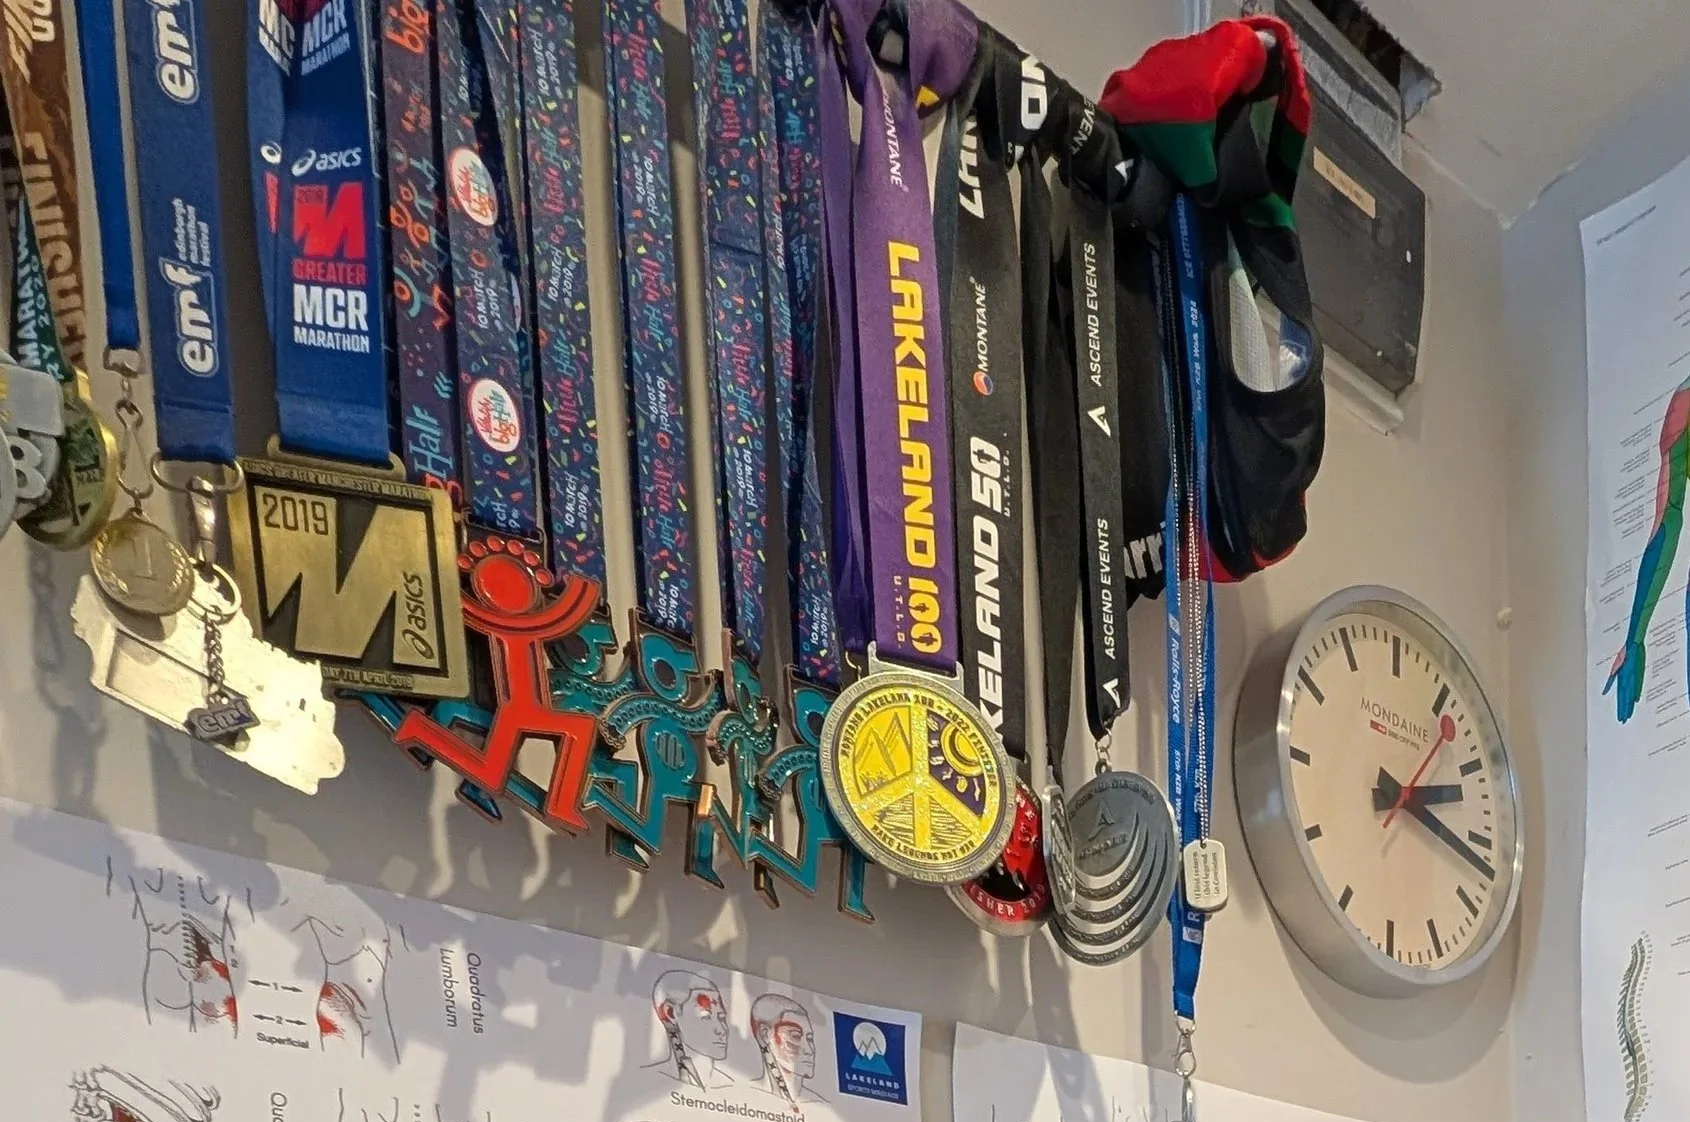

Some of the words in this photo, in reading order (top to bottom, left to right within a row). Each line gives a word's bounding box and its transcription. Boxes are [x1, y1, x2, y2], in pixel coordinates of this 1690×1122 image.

[292, 258, 367, 285] GREATER
[1083, 242, 1098, 313] EVENTS
[162, 261, 216, 375] emf
[293, 283, 369, 332] MCR
[294, 325, 370, 353] MARATHON
[977, 281, 991, 372] MONTANE
[1087, 318, 1102, 388] ASCEND
[887, 240, 938, 567] LAKELAND
[404, 404, 455, 482] Half
[969, 436, 1002, 512] 50
[262, 492, 329, 536] 2019
[1096, 518, 1112, 585] EVENTS
[402, 571, 428, 632] asics
[907, 577, 944, 655] 100
[972, 515, 1004, 740] KELAND
[1101, 586, 1115, 661] ASCEND
[1360, 696, 1429, 743] MONDAINE
[439, 947, 459, 1028] Lumborum
[466, 952, 484, 1035] Quadratus
[256, 1032, 310, 1049] Superficial
[845, 1072, 900, 1090] LAKELAND
